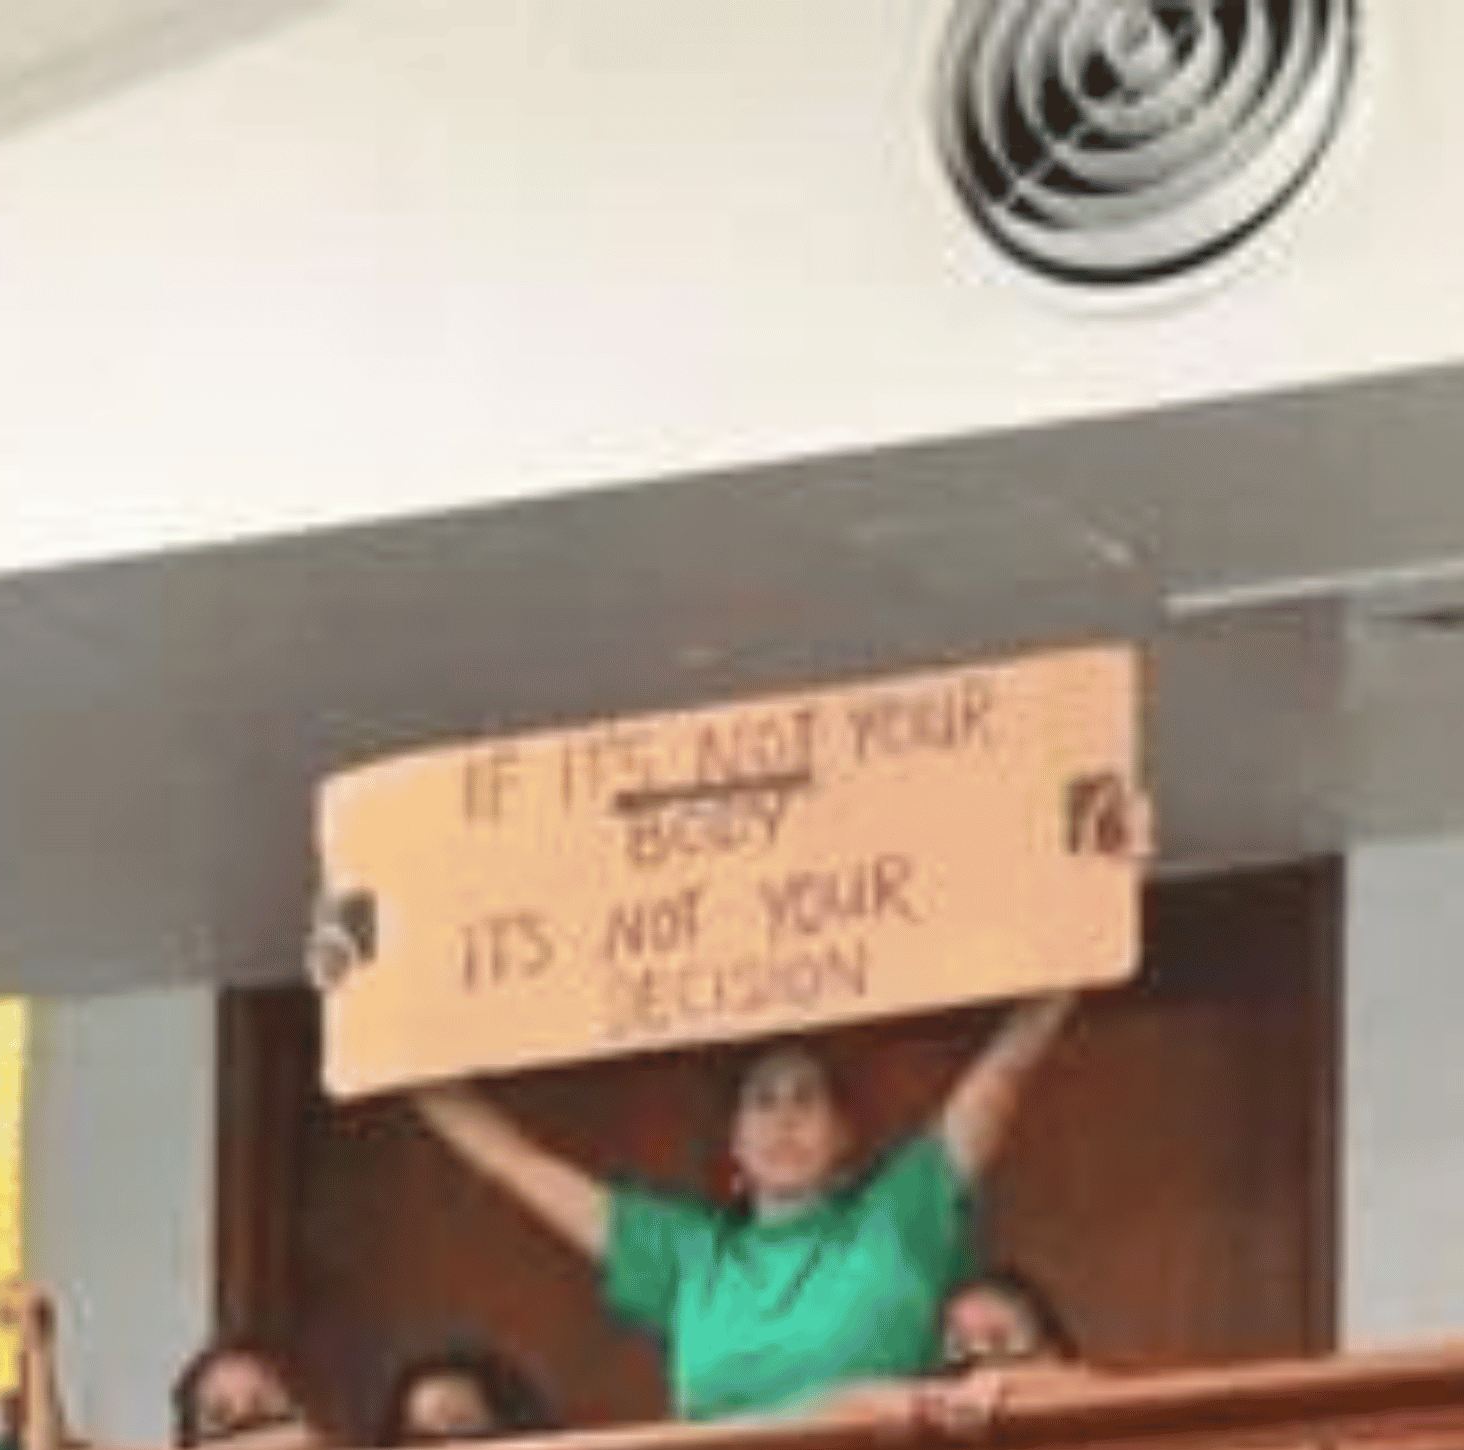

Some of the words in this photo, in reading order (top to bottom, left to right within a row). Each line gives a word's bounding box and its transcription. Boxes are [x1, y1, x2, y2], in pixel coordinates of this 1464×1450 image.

[460, 746, 520, 824] IF
[696, 706, 816, 785] NOT
[848, 674, 994, 764] YOUR
[626, 782, 786, 868] BODY
[604, 882, 705, 962] NOT
[758, 853, 925, 948] YOUR
[604, 936, 868, 1039] DECISION
